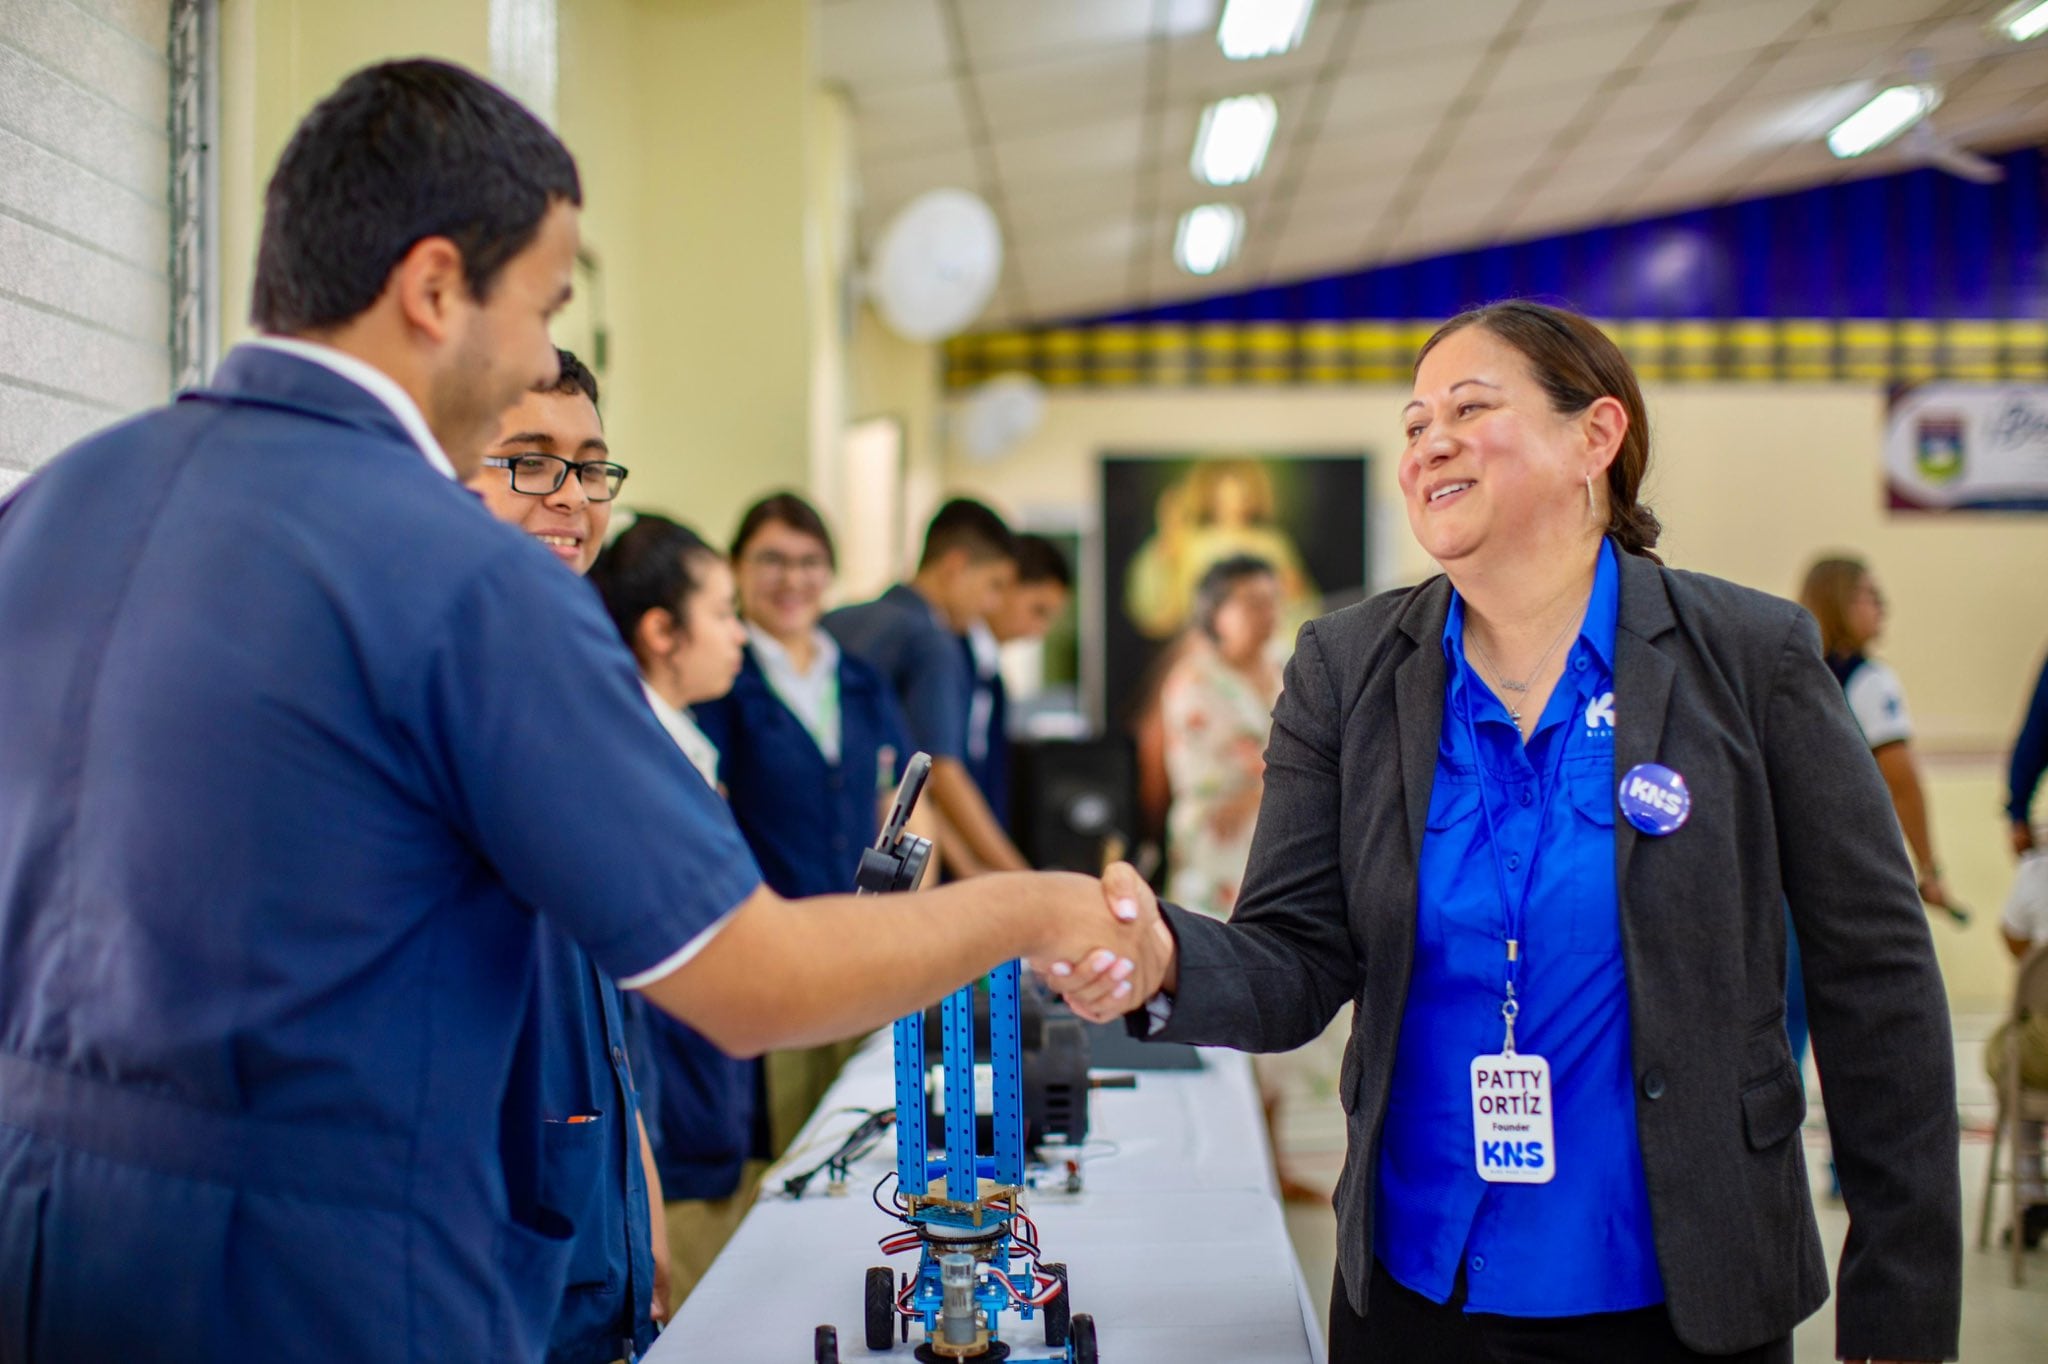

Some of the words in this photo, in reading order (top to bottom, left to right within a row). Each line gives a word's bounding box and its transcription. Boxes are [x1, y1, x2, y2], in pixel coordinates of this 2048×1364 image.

[1629, 777, 1682, 815] KNS
[1477, 1070, 1541, 1089] PATTY
[1480, 1091, 1541, 1115] ORTÍZ
[1493, 1122, 1530, 1132] Founder
[1482, 1140, 1544, 1168] KNS
